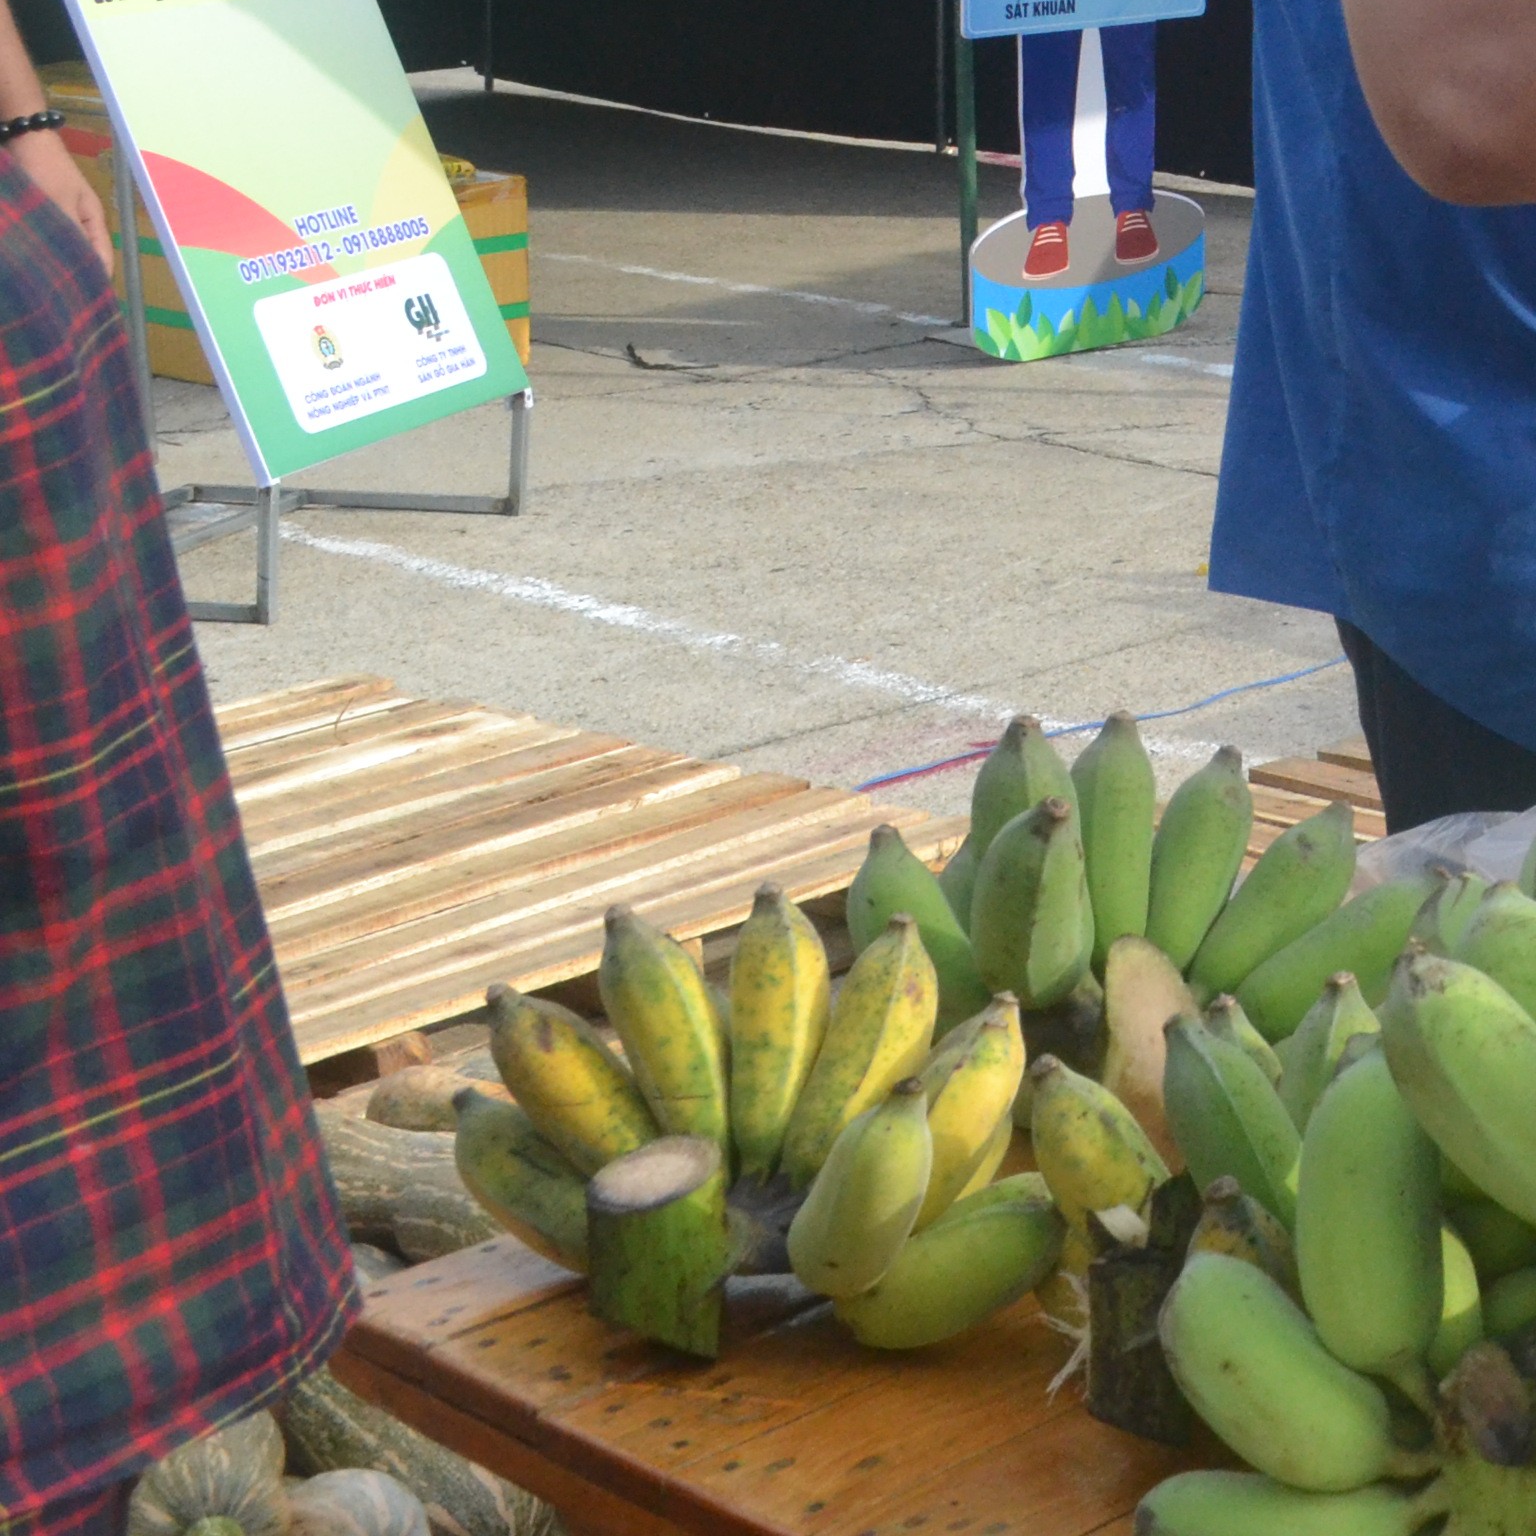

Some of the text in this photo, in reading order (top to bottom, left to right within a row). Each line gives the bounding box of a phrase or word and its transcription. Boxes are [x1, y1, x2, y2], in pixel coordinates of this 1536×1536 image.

[1005, 0, 1030, 19] SÁT
[294, 205, 358, 237] HOTLINE
[239, 242, 334, 282] 0911932112
[342, 217, 429, 255] 0918888005
